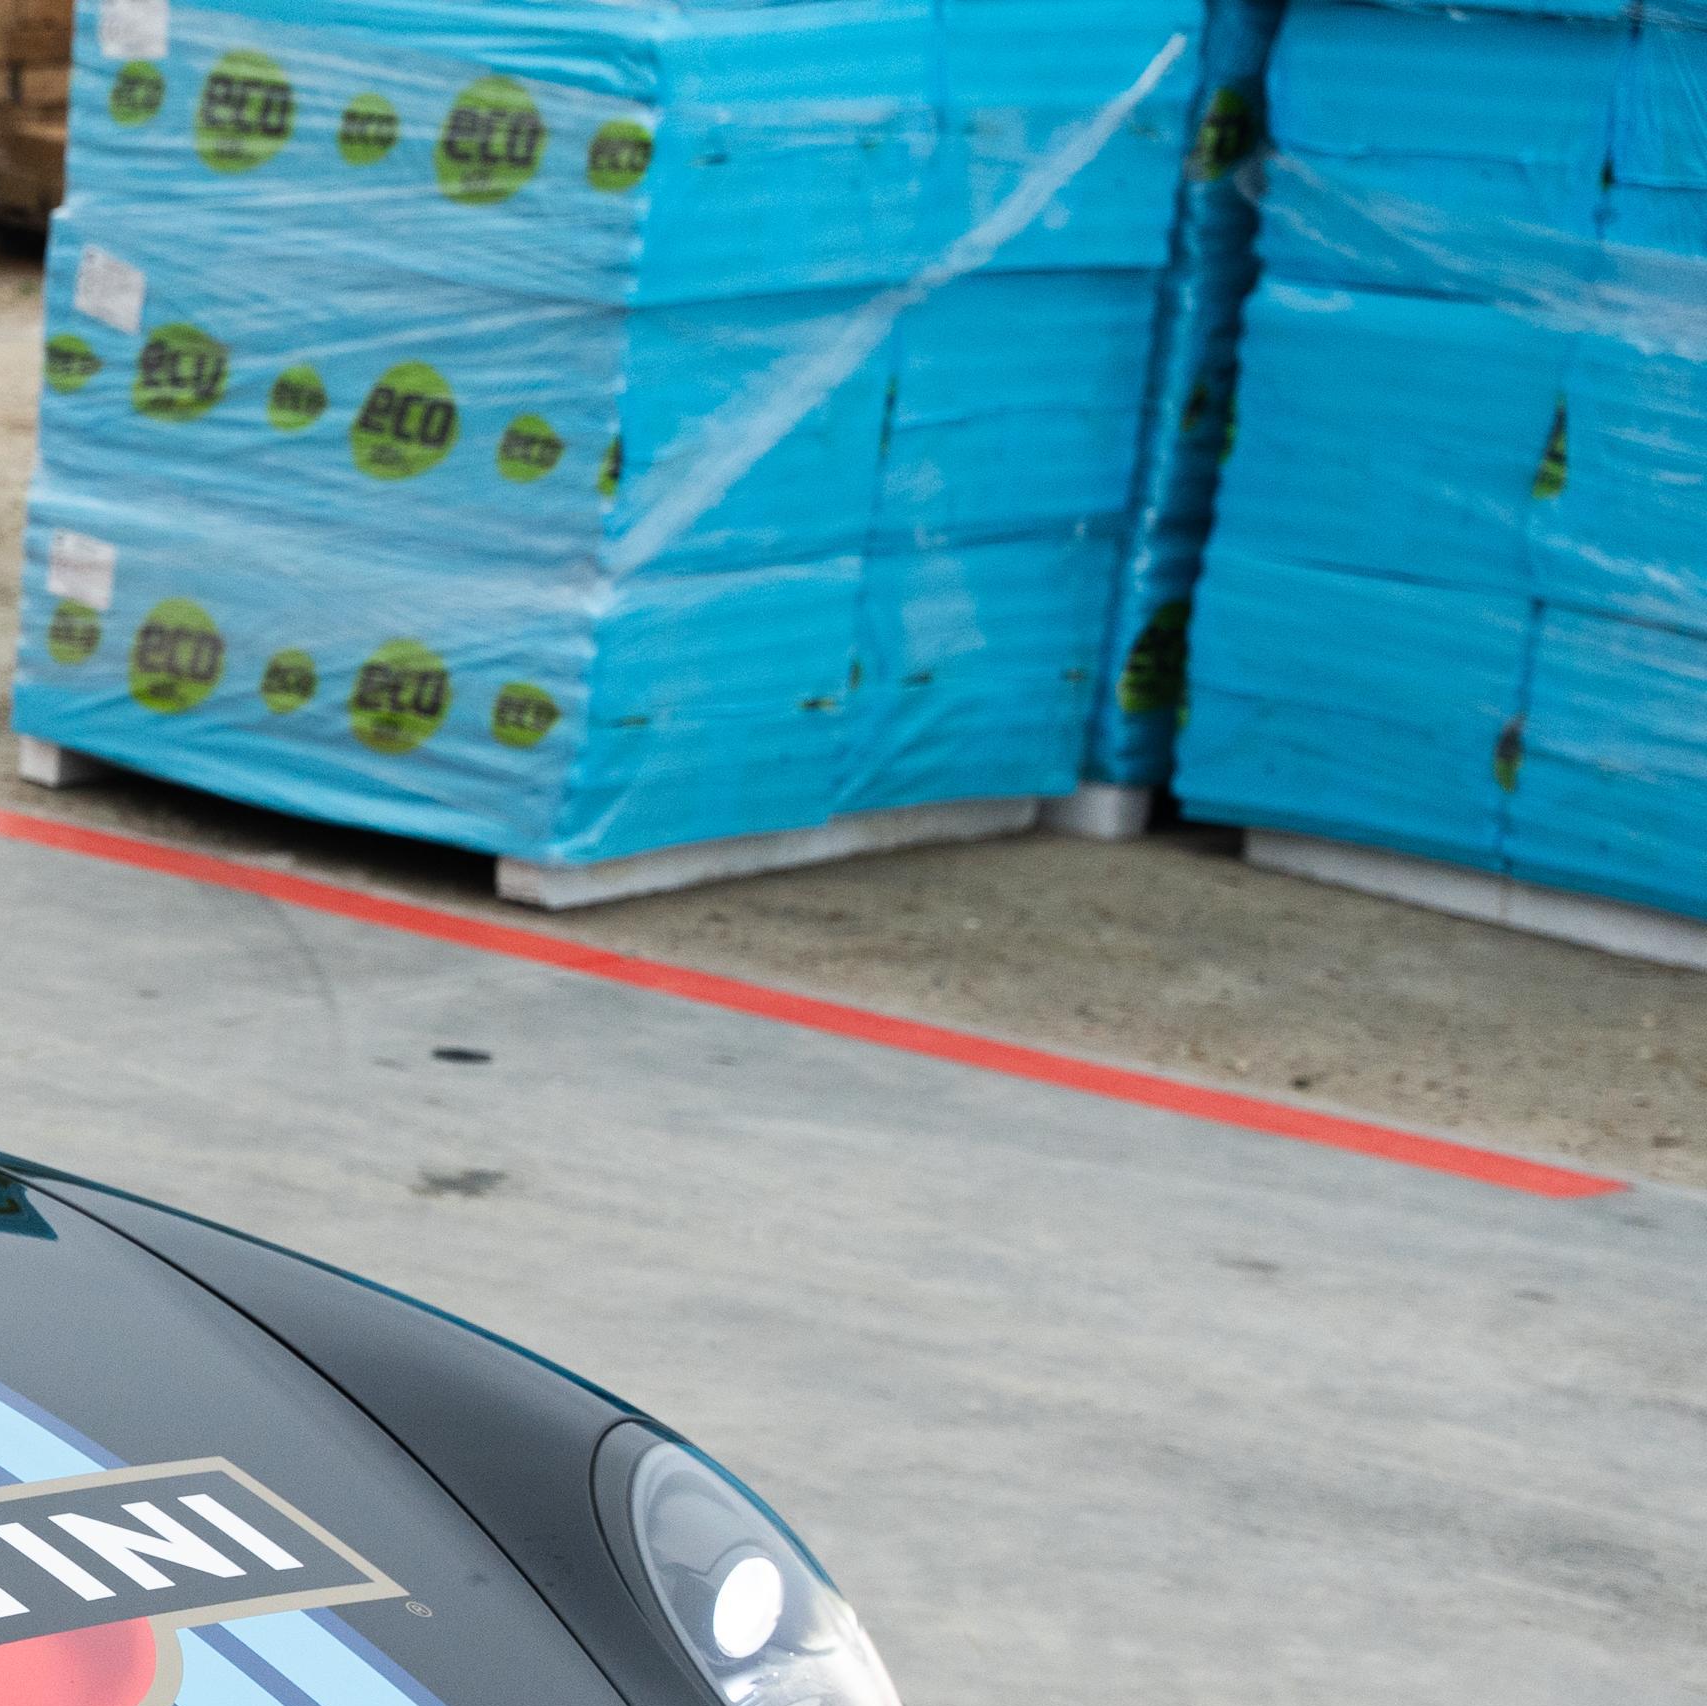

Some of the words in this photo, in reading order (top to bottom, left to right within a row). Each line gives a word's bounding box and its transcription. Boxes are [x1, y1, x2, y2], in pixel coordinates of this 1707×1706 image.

[201, 74, 293, 136] eco
[444, 107, 544, 167] eco
[358, 384, 457, 447] eco
[136, 622, 227, 681] eco
[353, 664, 450, 718] eco
